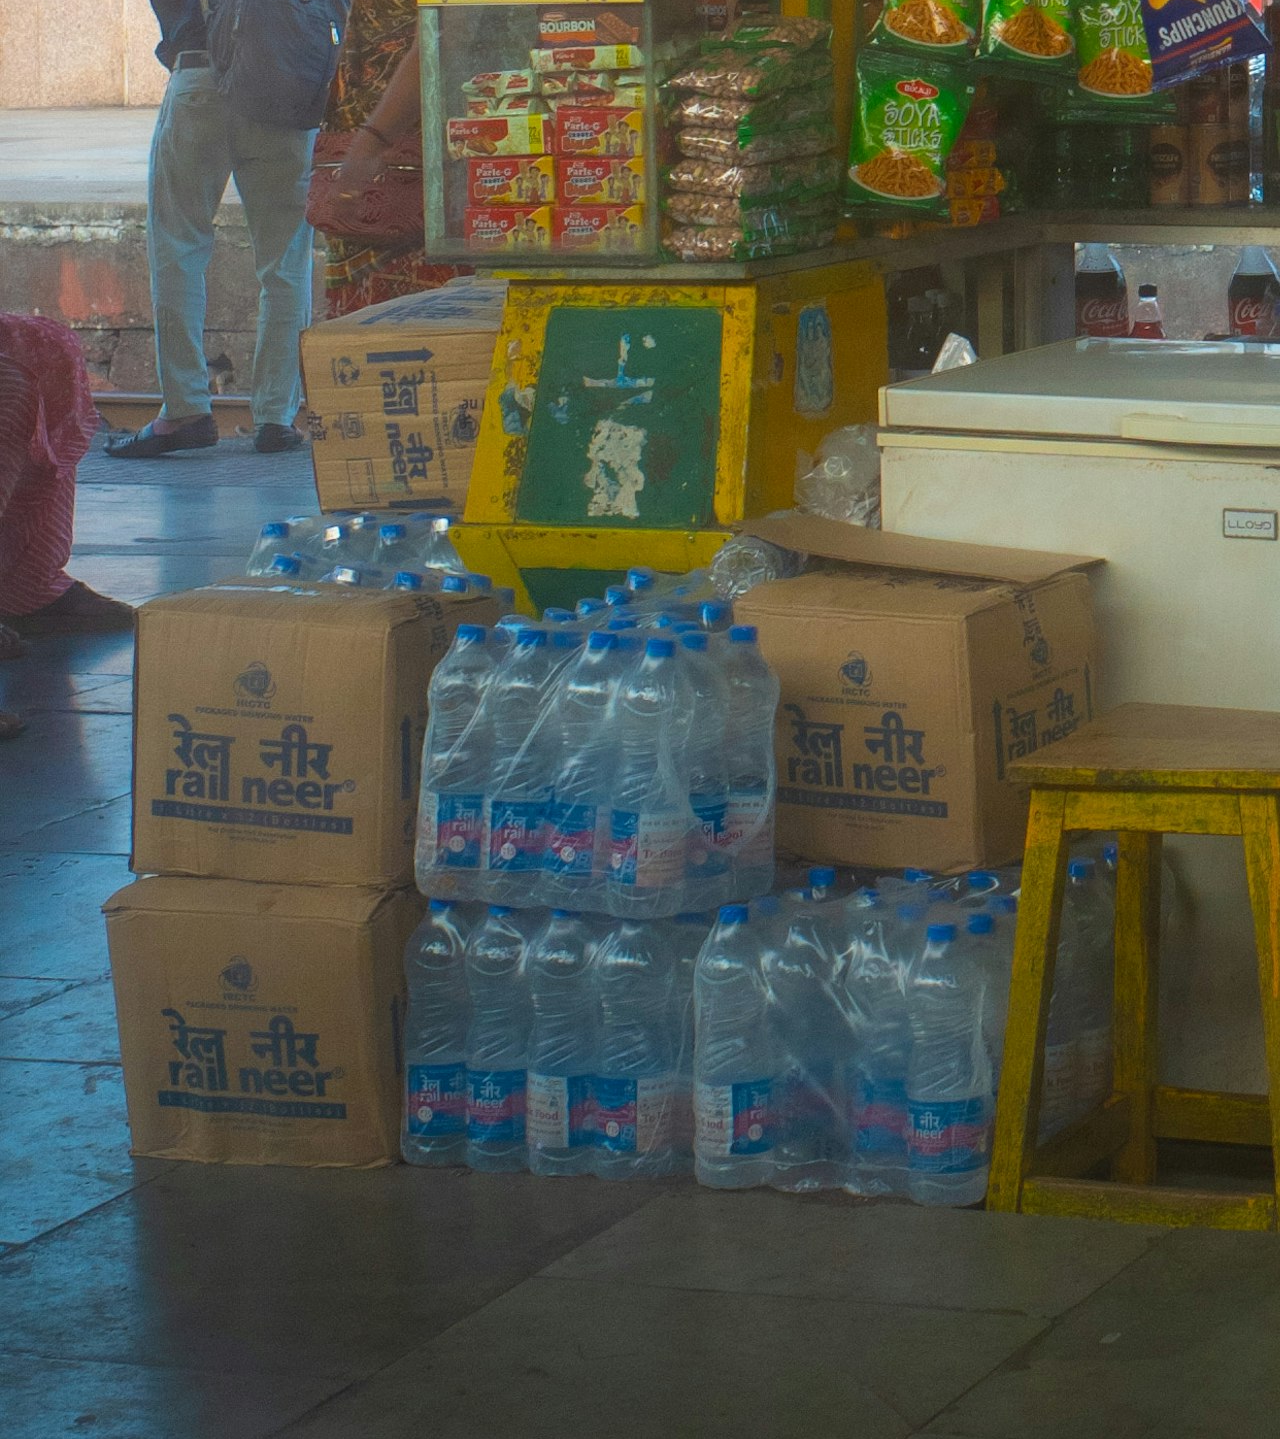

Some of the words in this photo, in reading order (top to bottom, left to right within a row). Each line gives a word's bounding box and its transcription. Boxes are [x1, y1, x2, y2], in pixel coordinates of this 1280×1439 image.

[539, 19, 596, 34] BOURBON
[884, 101, 942, 127] SOYA
[882, 125, 943, 151] STICKS
[1227, 519, 1273, 531] LLOYD
[841, 686, 872, 698] IRCTC
[167, 712, 236, 771] रेल
[259, 722, 334, 781] नीर
[863, 710, 926, 766] नीर
[165, 767, 231, 802] rail
[160, 1007, 227, 1063] रेल
[250, 1014, 321, 1069] नीर
[168, 1060, 229, 1092] rail
